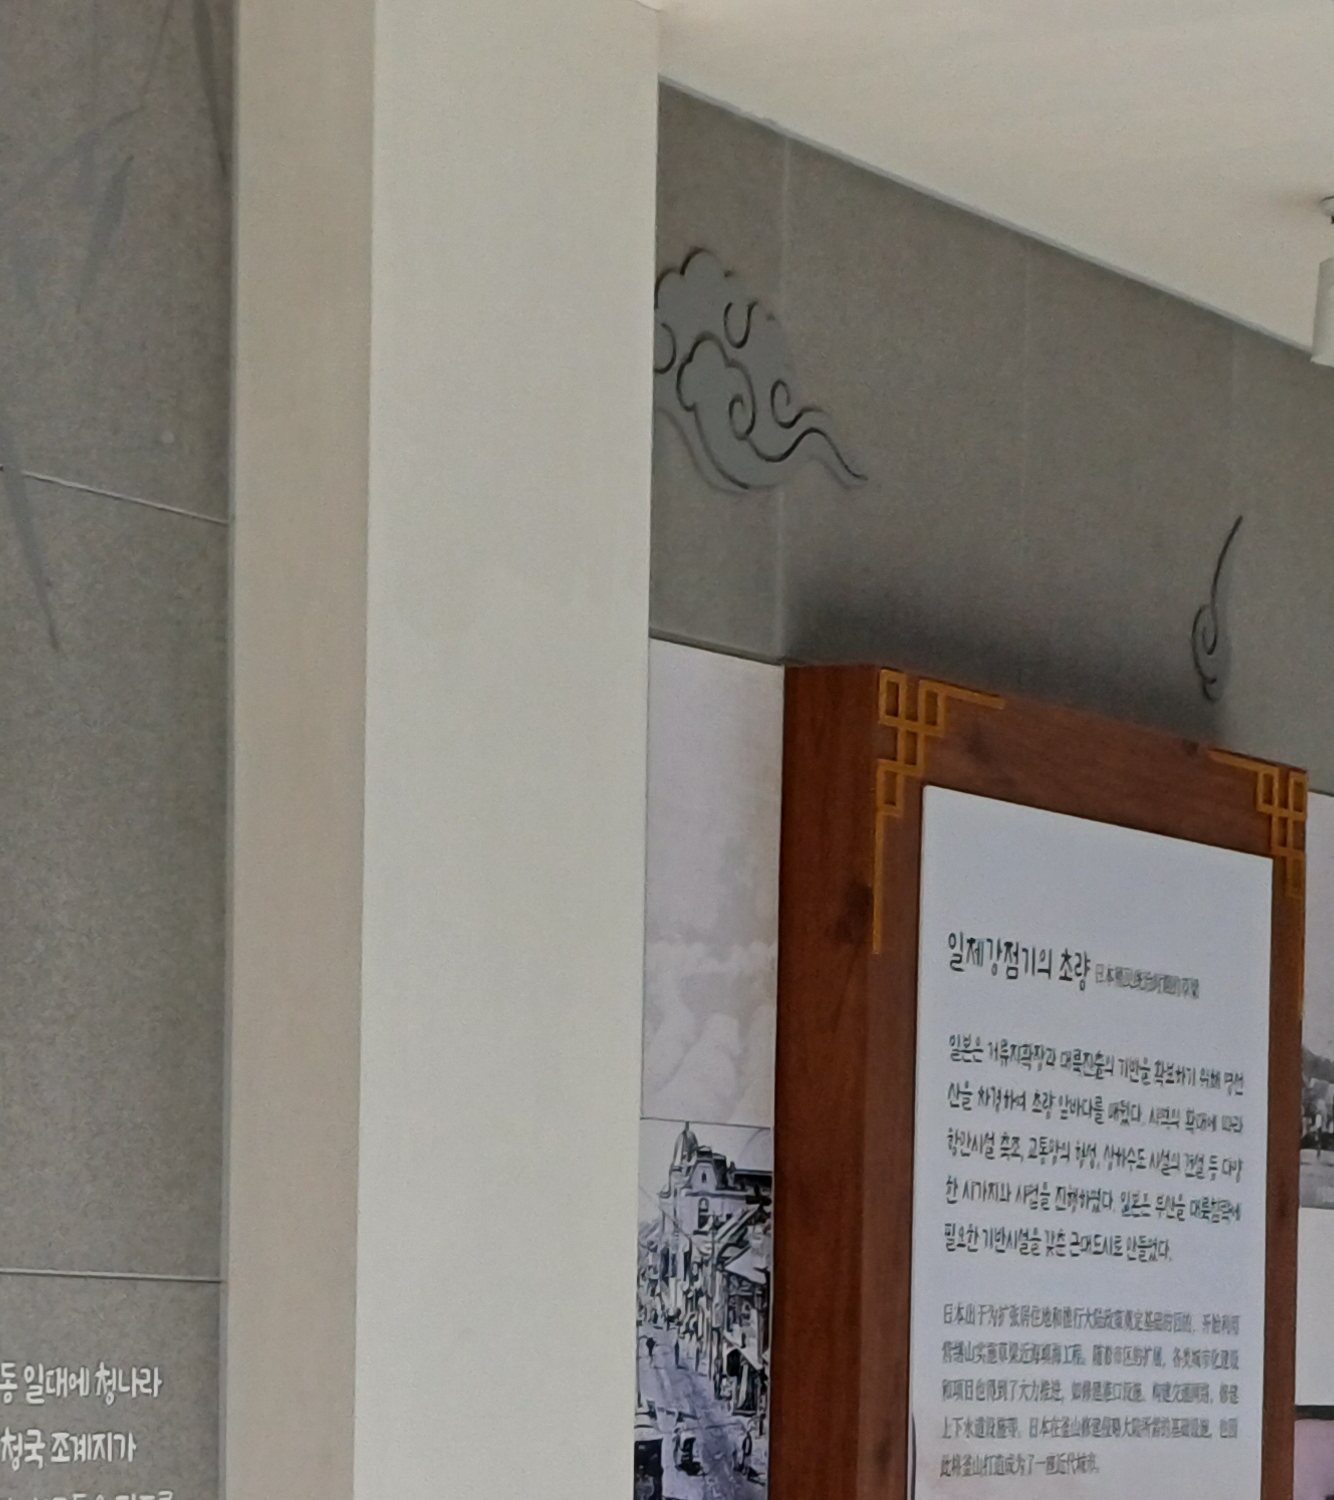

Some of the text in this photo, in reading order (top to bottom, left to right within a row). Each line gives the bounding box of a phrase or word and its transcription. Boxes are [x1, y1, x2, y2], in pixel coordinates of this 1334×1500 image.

[948, 932, 1052, 980] 일제강점기의
[1059, 948, 1090, 991] 초량
[949, 1034, 984, 1062] 일본은
[948, 1081, 973, 1111] 산을
[1032, 1089, 1056, 1119] 초량
[1209, 1155, 1218, 1181] 등
[946, 1175, 958, 1204] 한
[945, 1223, 978, 1253] 필요한
[982, 1227, 1042, 1256] 기반시설을
[23, 1362, 90, 1405] 일대에
[94, 1361, 163, 1406] 청나라
[0, 1426, 46, 1471] 청국
[50, 1430, 138, 1464] 조계지가
